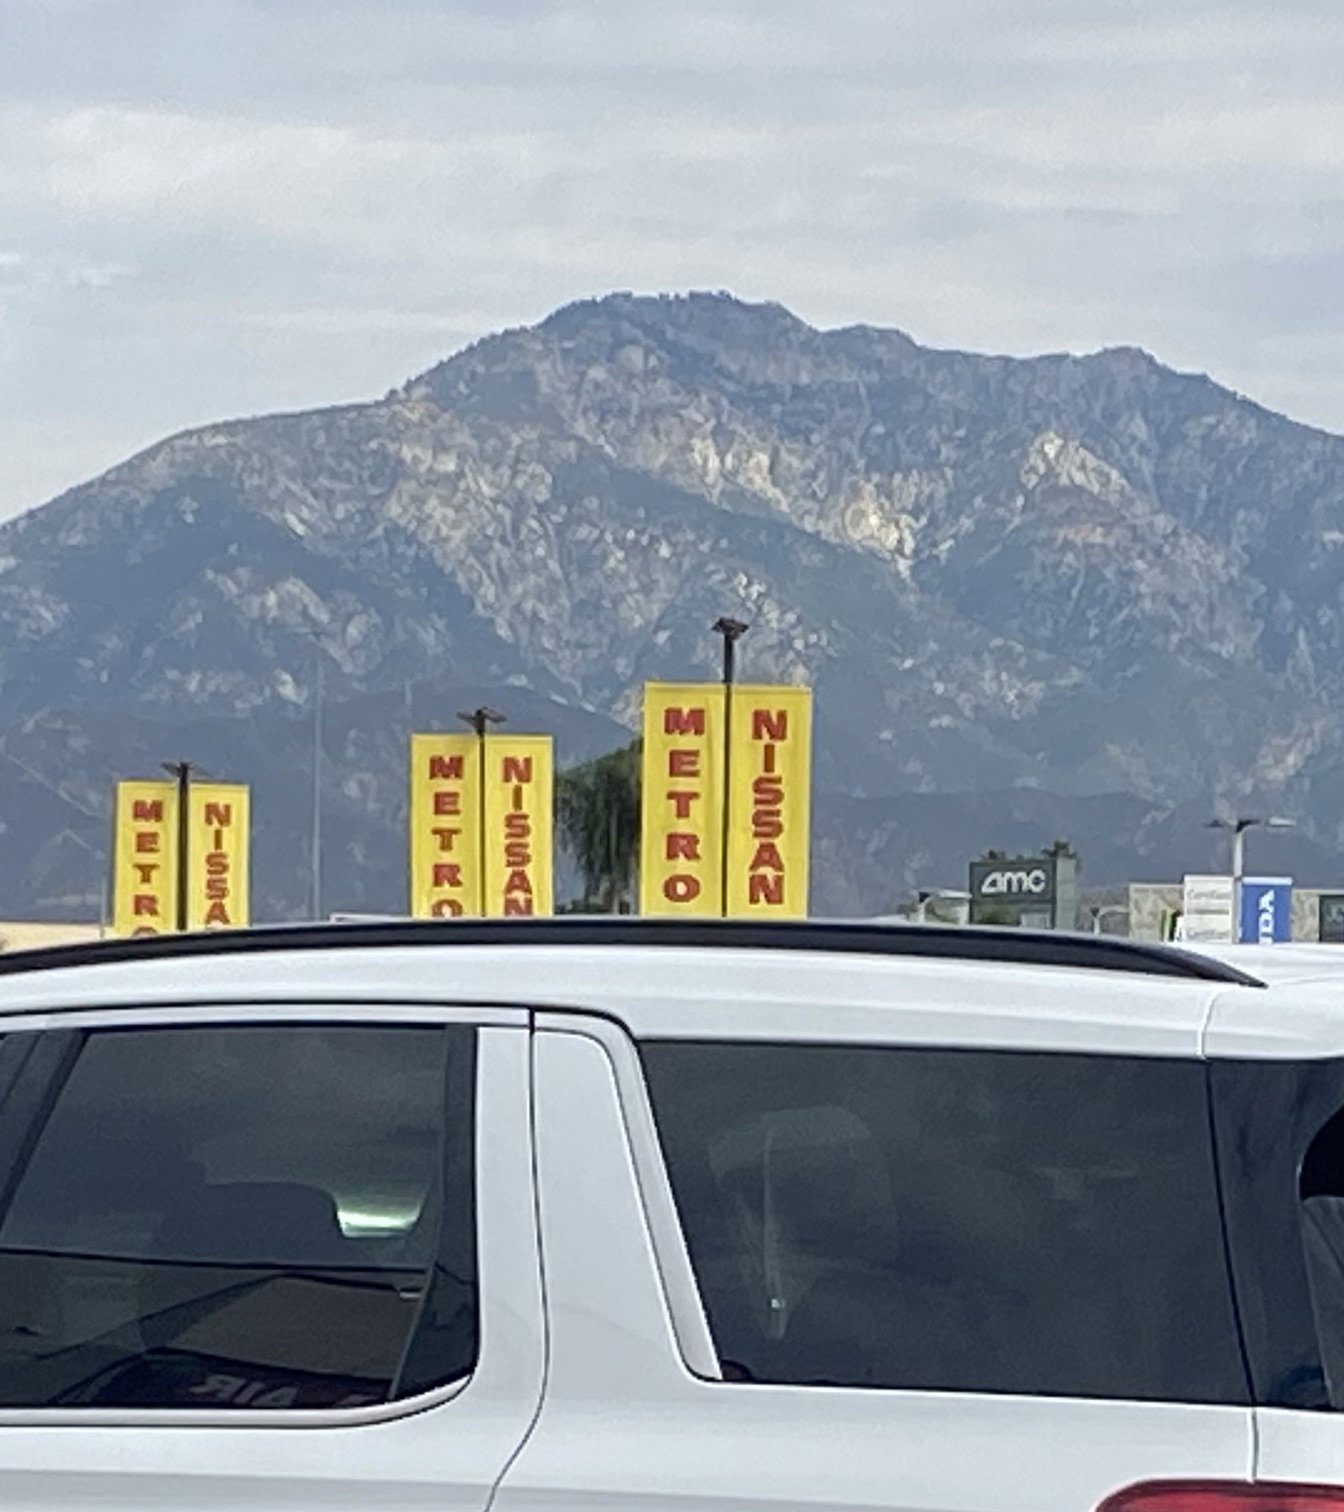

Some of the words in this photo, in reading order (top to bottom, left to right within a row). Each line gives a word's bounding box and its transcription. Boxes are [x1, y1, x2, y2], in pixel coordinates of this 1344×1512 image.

[428, 755, 463, 917] METRO
[502, 756, 533, 916] NISSAN
[663, 706, 706, 902] METRO
[749, 709, 788, 905] NISSAN
